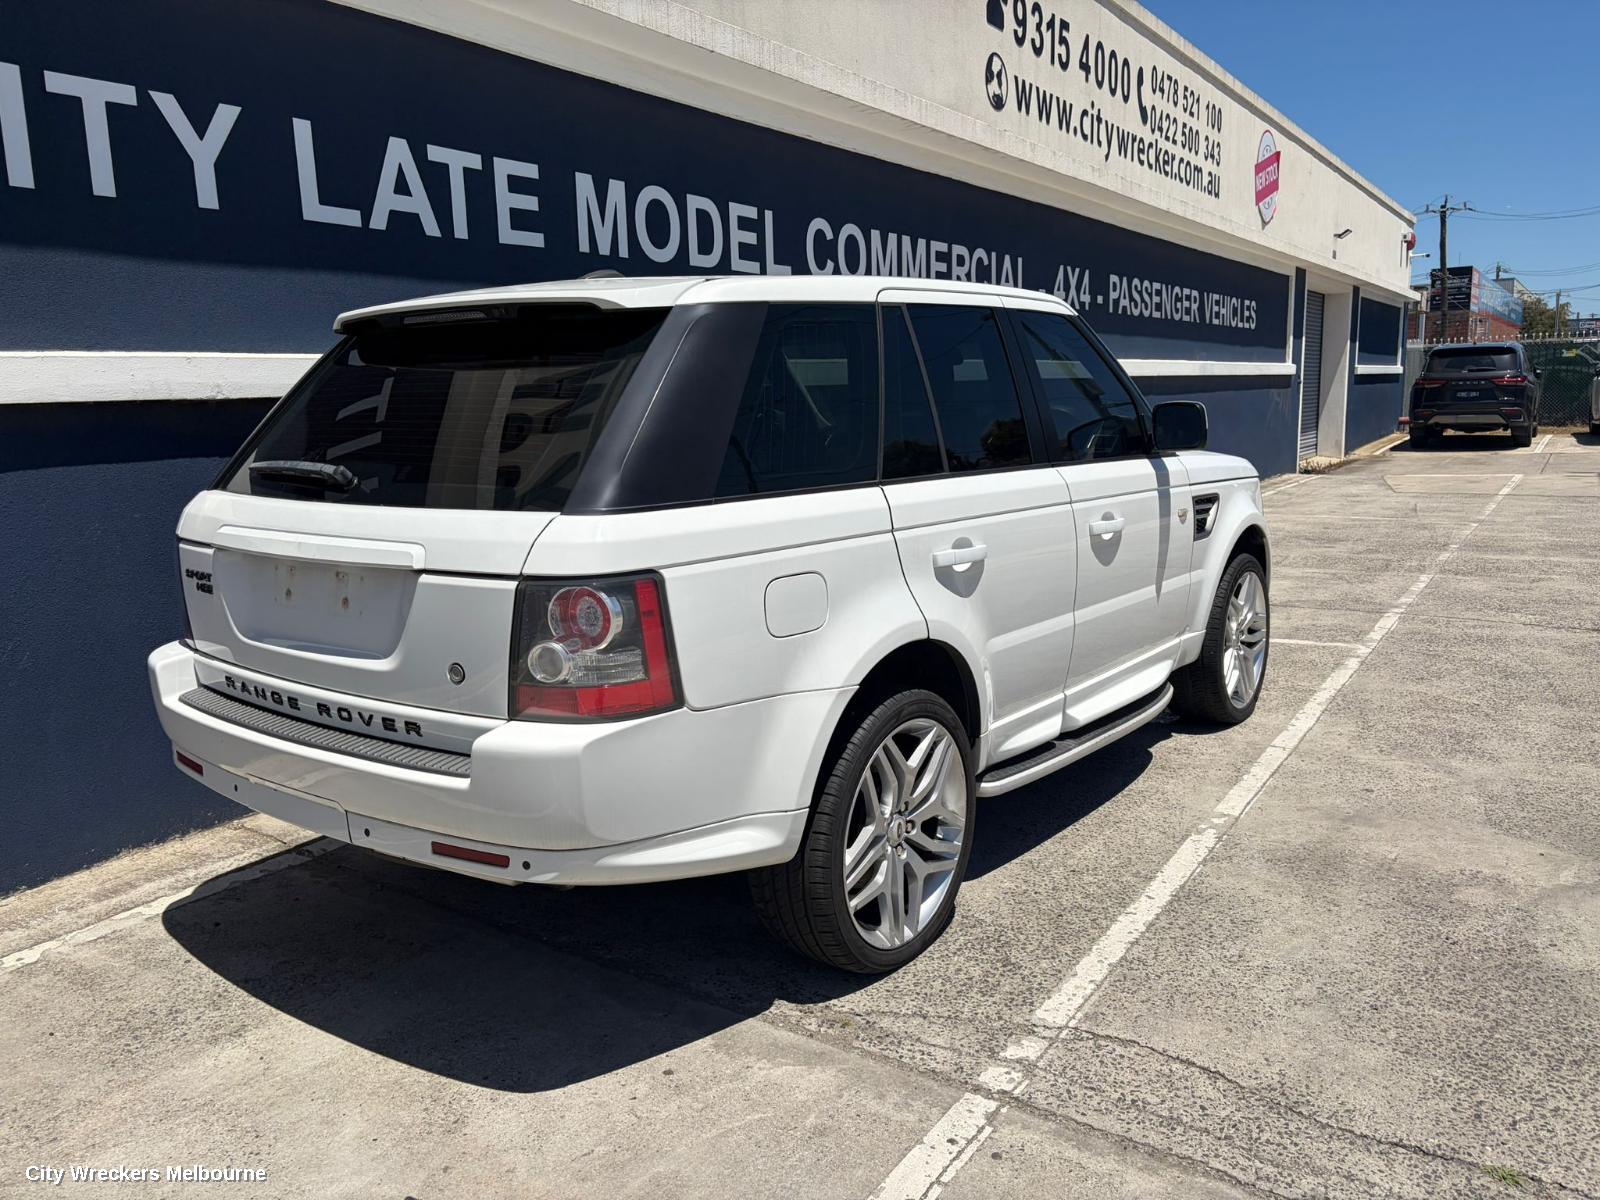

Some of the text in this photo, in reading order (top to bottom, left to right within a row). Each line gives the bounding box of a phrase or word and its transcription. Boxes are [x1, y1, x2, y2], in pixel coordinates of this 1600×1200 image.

[1013, 0, 1131, 104] 9315 4000
[1014, 75, 1221, 200] www.citywrecker.com.au
[1150, 104, 1222, 168] 0422 500 343
[1151, 65, 1223, 134] 0478 521 100
[292, 117, 545, 248] LATE
[575, 171, 792, 276] MODEL
[1053, 264, 1091, 311] 4X4
[1108, 273, 1200, 323] PASSENGER
[1204, 291, 1257, 330] VEHICLES
[225, 675, 423, 738] RANGE ROVER
